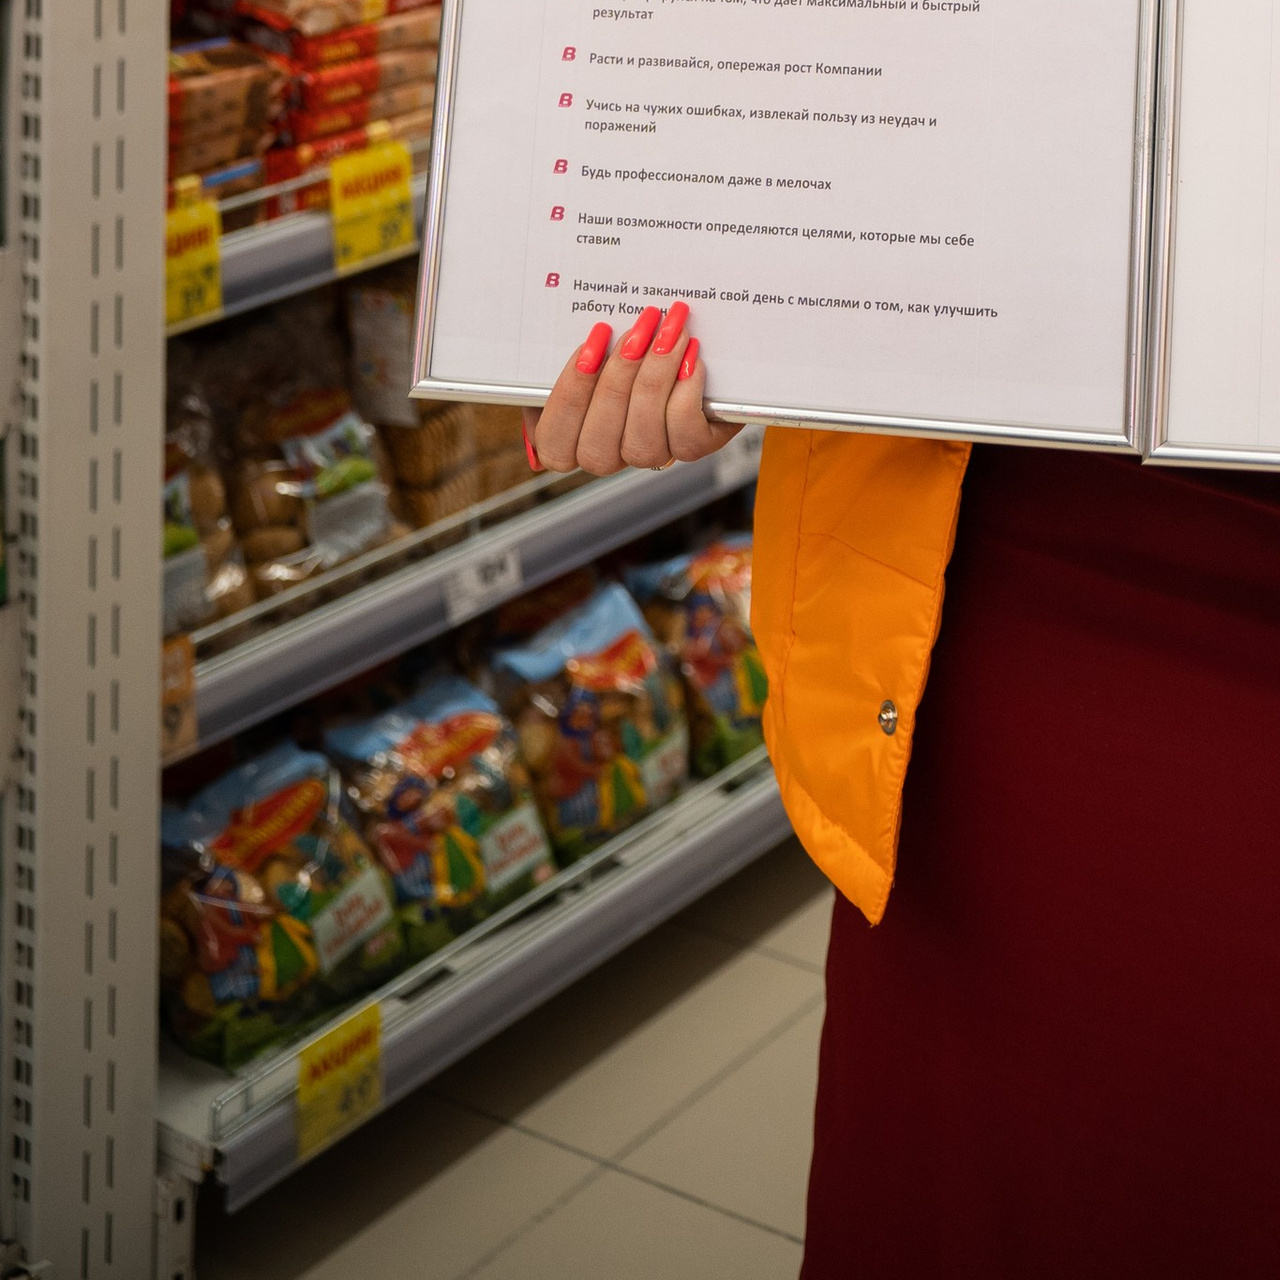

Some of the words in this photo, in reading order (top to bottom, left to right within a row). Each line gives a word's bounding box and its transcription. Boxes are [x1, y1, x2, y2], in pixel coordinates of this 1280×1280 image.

[592, 8, 654, 22] результат
[910, 1, 919, 11] и
[589, 52, 624, 65] Расти
[626, 56, 635, 66] и
[637, 56, 714, 72] развивайся,
[716, 60, 781, 74] опережая
[783, 63, 813, 76] рост
[815, 62, 883, 77] Компании
[585, 98, 622, 112] Учись
[625, 103, 640, 113] на
[643, 104, 683, 117] чужих
[685, 104, 746, 121] ошибках,
[749, 108, 810, 121] извлекай
[812, 112, 858, 126] пользу
[860, 114, 876, 125] из
[878, 115, 926, 129] неудач
[928, 117, 937, 127] и
[584, 120, 657, 134] поражений
[581, 165, 612, 180] Будь
[614, 167, 725, 185] профессионалом
[727, 175, 762, 188] даже
[765, 177, 773, 187] в
[775, 178, 832, 190] мелочах
[576, 234, 621, 246] ставим
[577, 212, 613, 226] Наши
[616, 217, 703, 231] возможности
[705, 222, 799, 237] определяются
[801, 228, 856, 243] целями,
[859, 231, 916, 245] которые
[919, 234, 941, 245] мы
[944, 233, 975, 247] себе
[571, 299, 616, 316] работу
[573, 279, 628, 294] Начинай
[631, 285, 640, 295] и
[642, 284, 718, 300] заканчивай
[719, 289, 750, 302] свой
[752, 293, 785, 306] день
[787, 295, 795, 306] с
[797, 296, 860, 309] мыслями
[863, 300, 872, 310] о
[874, 301, 904, 315] том,
[907, 303, 930, 314] как
[933, 304, 999, 318] улучшить
